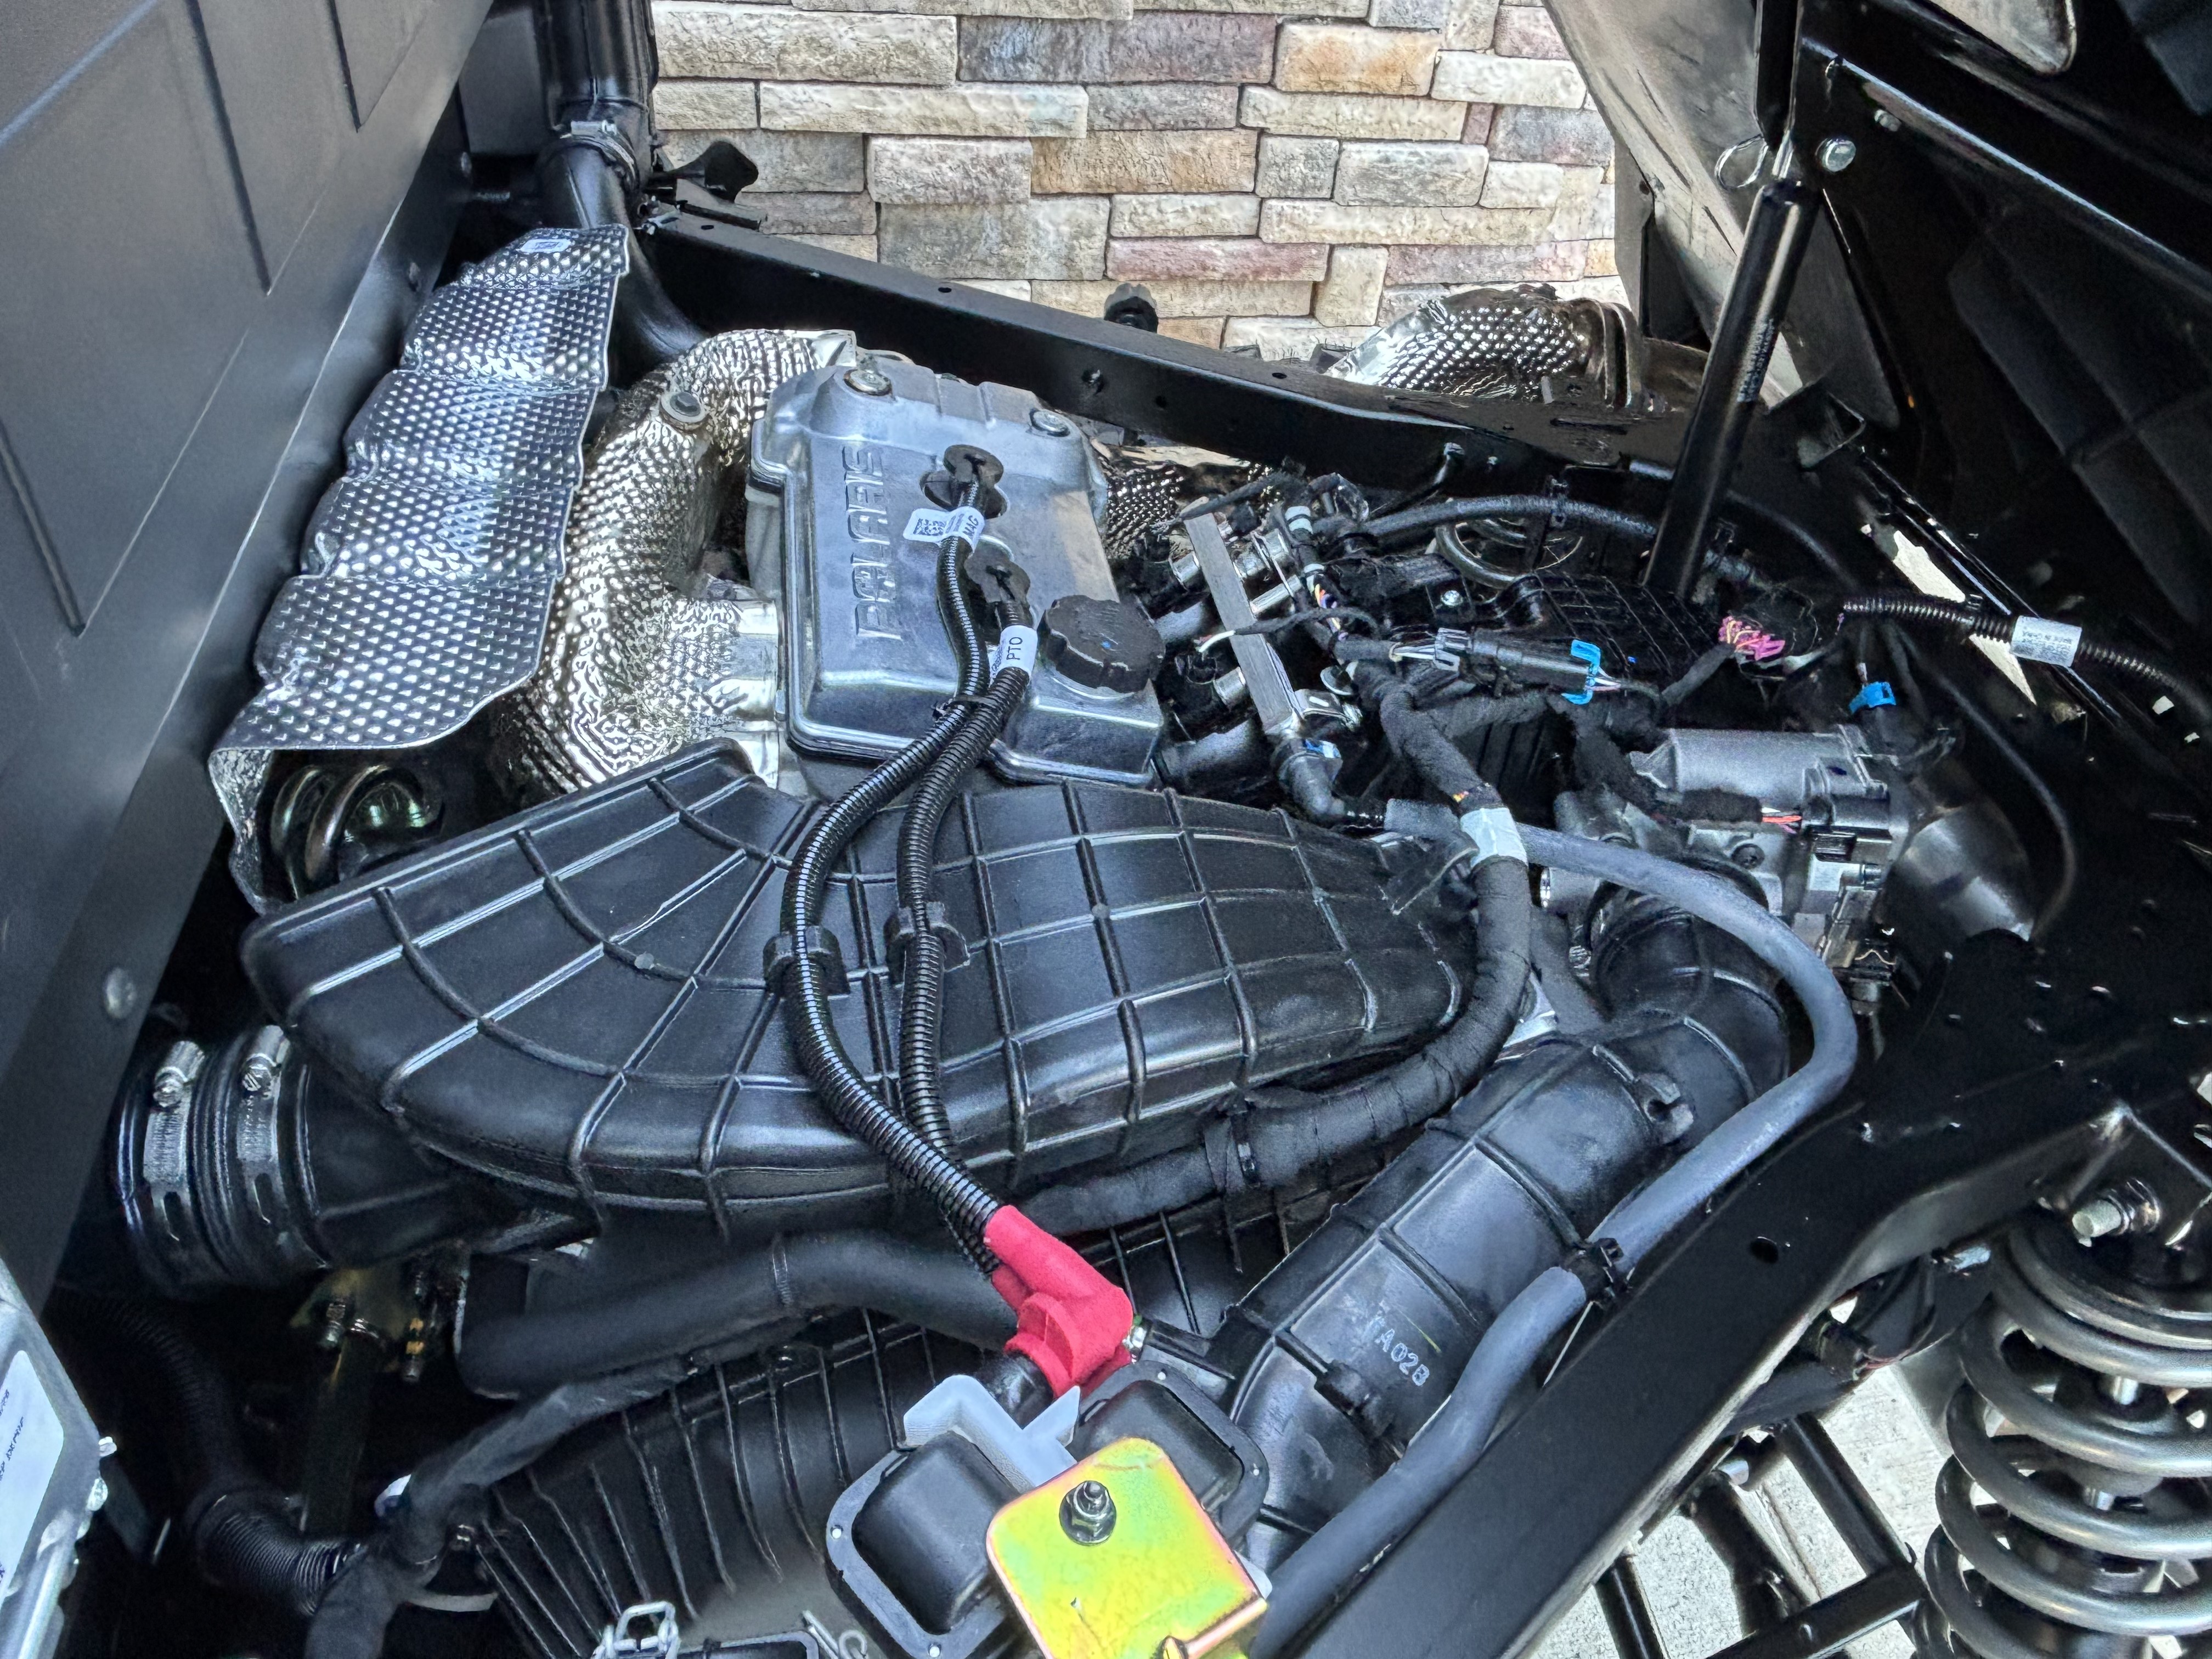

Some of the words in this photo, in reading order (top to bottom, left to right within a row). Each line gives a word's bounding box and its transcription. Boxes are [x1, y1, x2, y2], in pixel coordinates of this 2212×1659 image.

[962, 515, 979, 539] MAG
[842, 445, 903, 641] POLARIS
[1006, 636, 1023, 661] PTO
